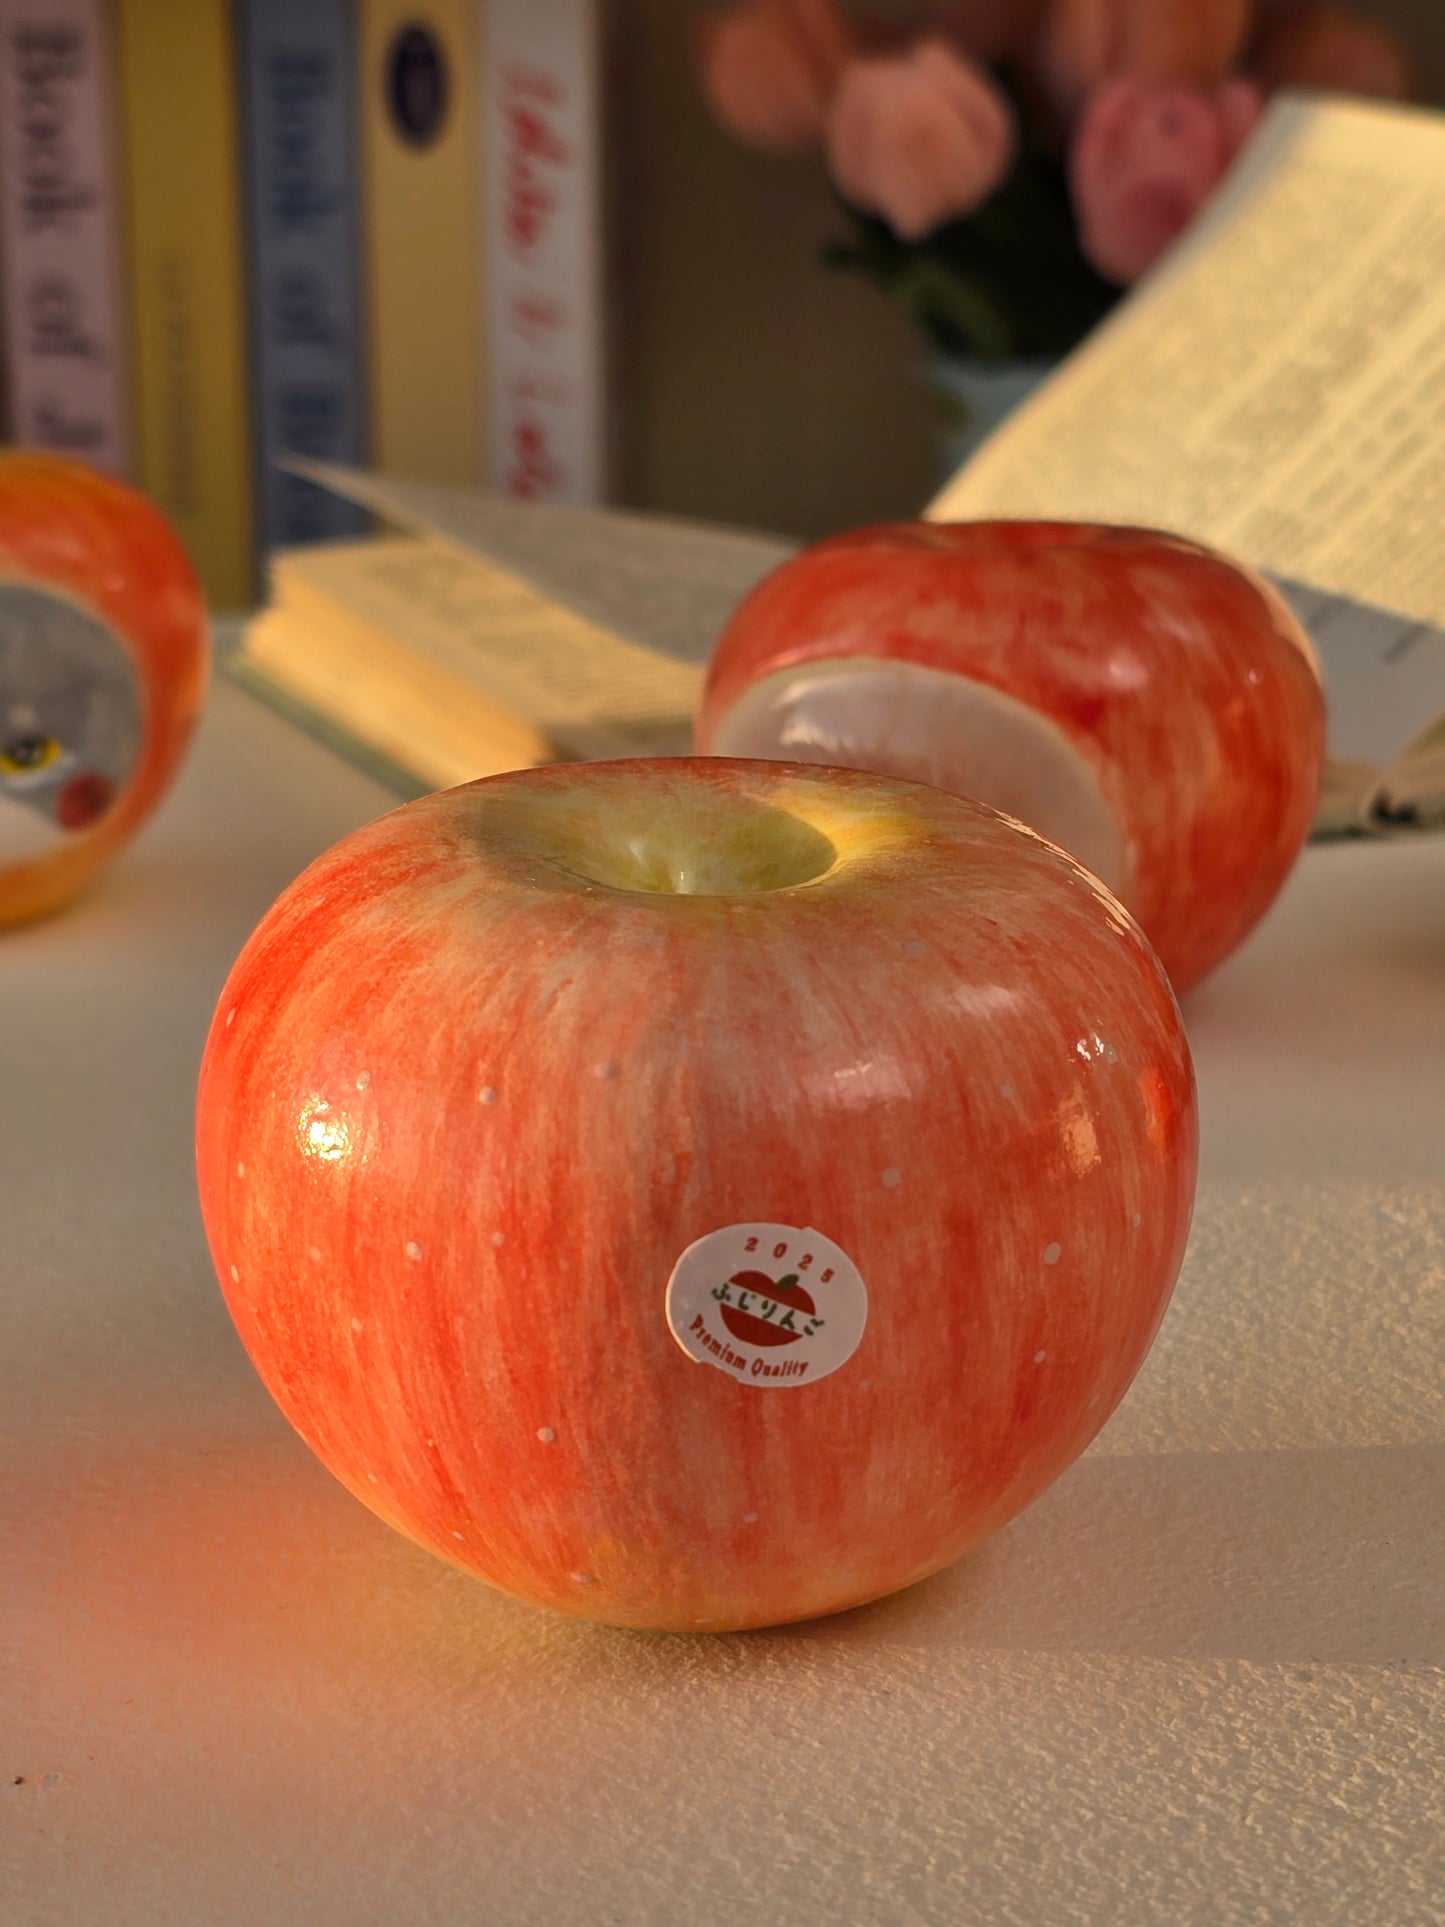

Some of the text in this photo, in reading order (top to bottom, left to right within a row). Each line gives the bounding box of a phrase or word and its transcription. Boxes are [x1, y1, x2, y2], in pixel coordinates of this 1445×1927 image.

[744, 1236, 835, 1284] 2025
[710, 1282, 825, 1337] ふじりんご
[688, 1313, 809, 1378] Premium Quality
